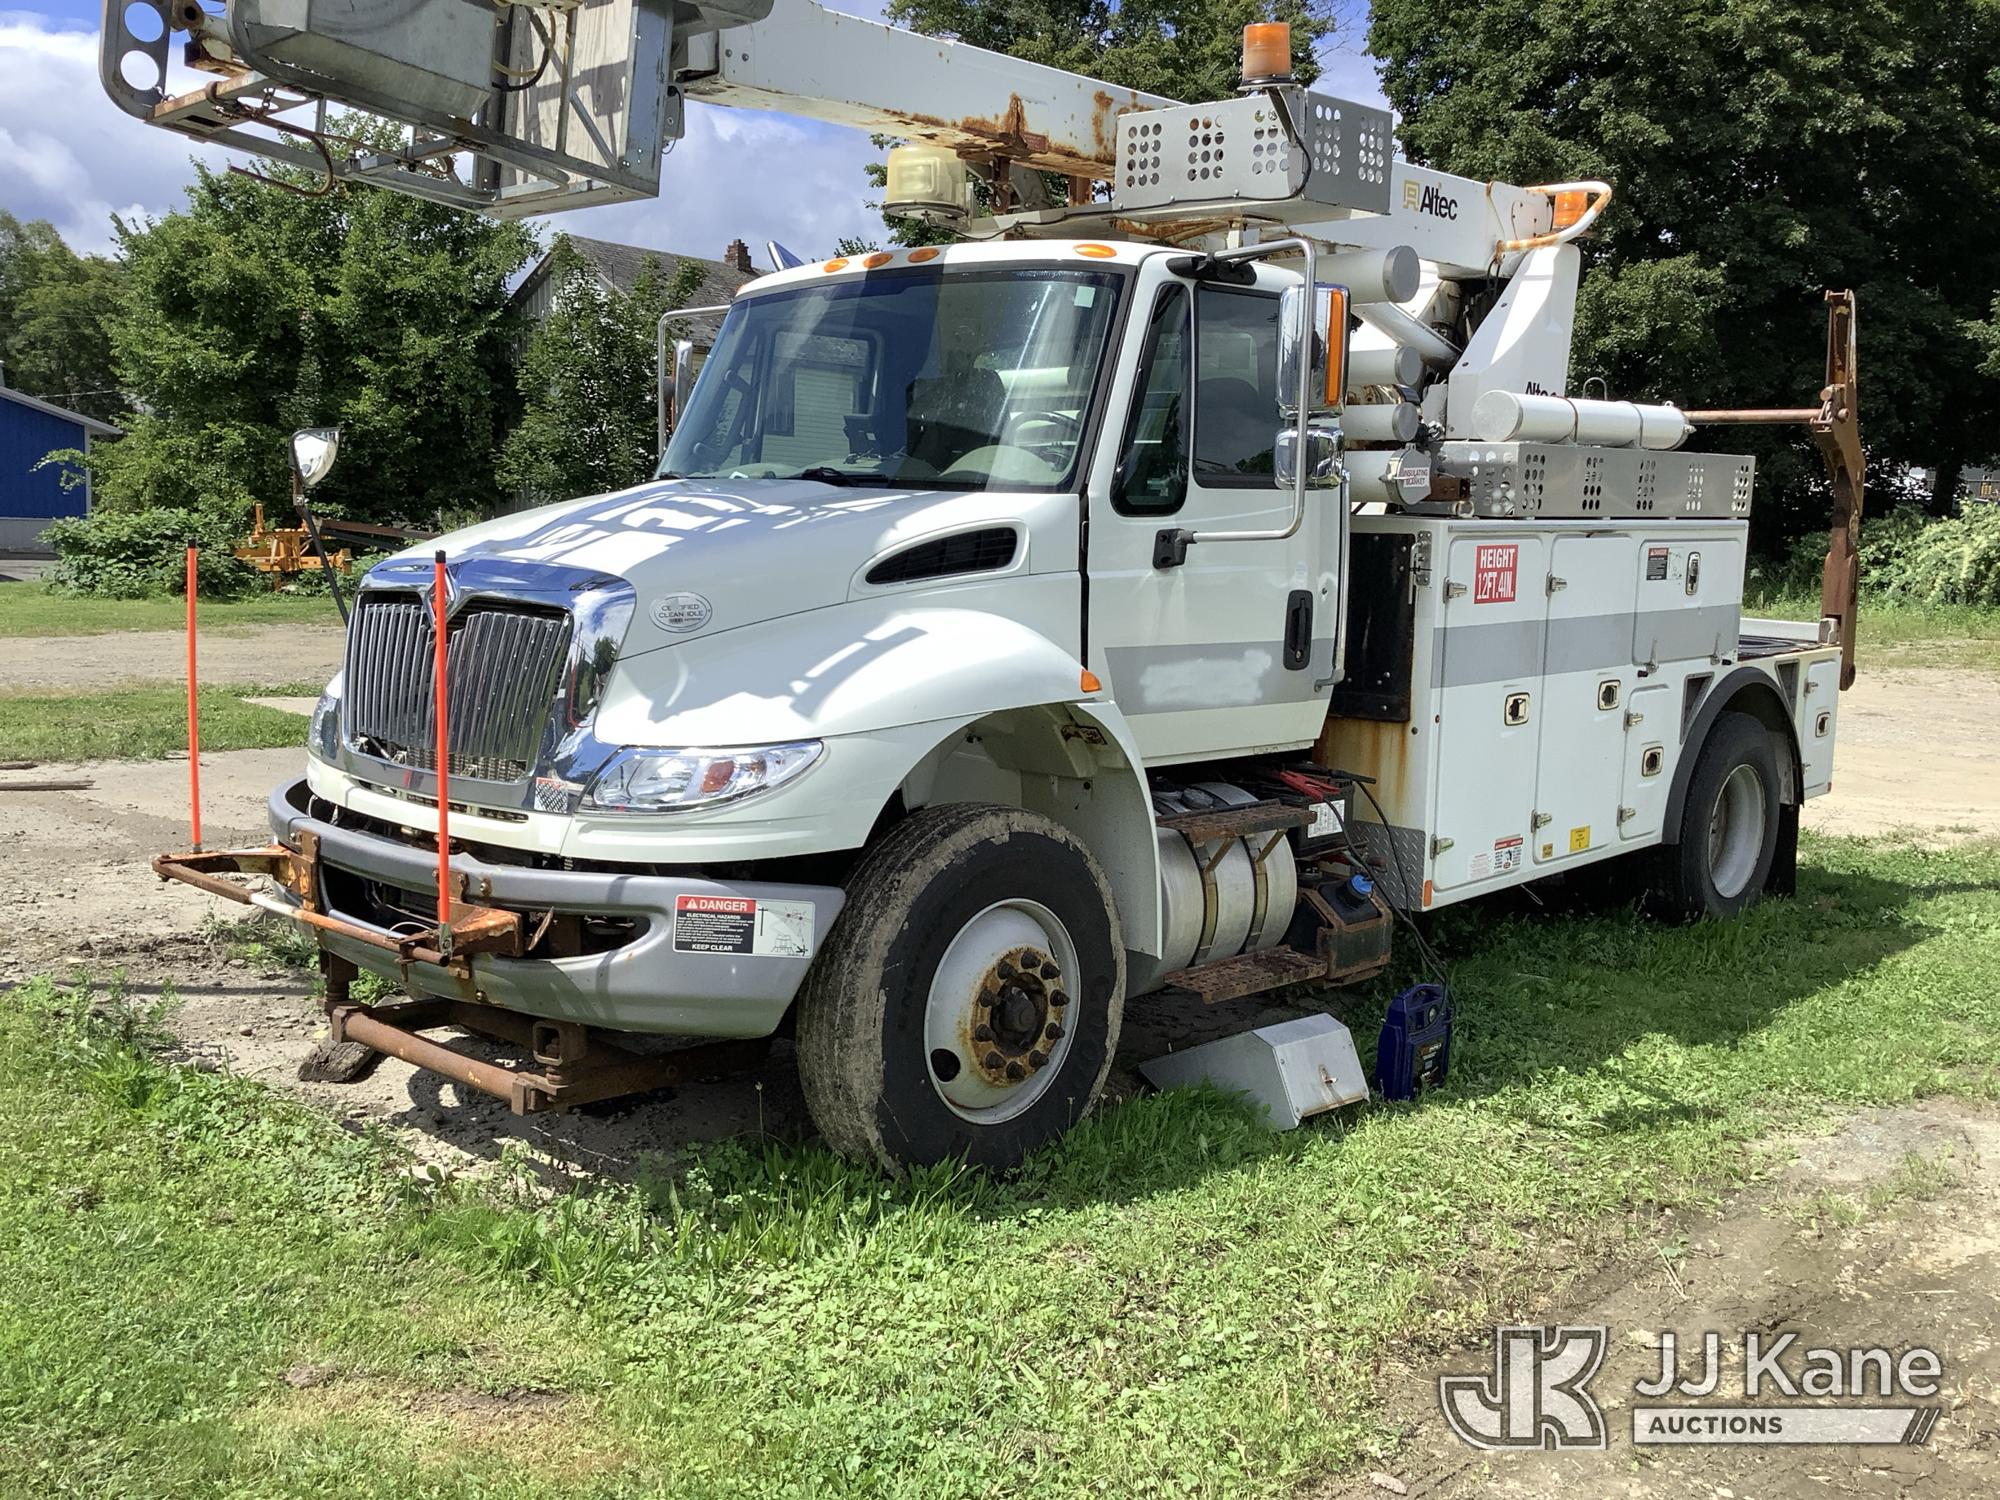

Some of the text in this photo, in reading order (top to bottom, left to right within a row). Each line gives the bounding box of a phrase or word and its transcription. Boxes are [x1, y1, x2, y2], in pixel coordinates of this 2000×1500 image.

[1420, 186, 1458, 220] Altec
[1525, 381, 1557, 396] Alt
[1480, 548, 1515, 568] HEIGHT
[699, 899, 748, 911] DANGER
